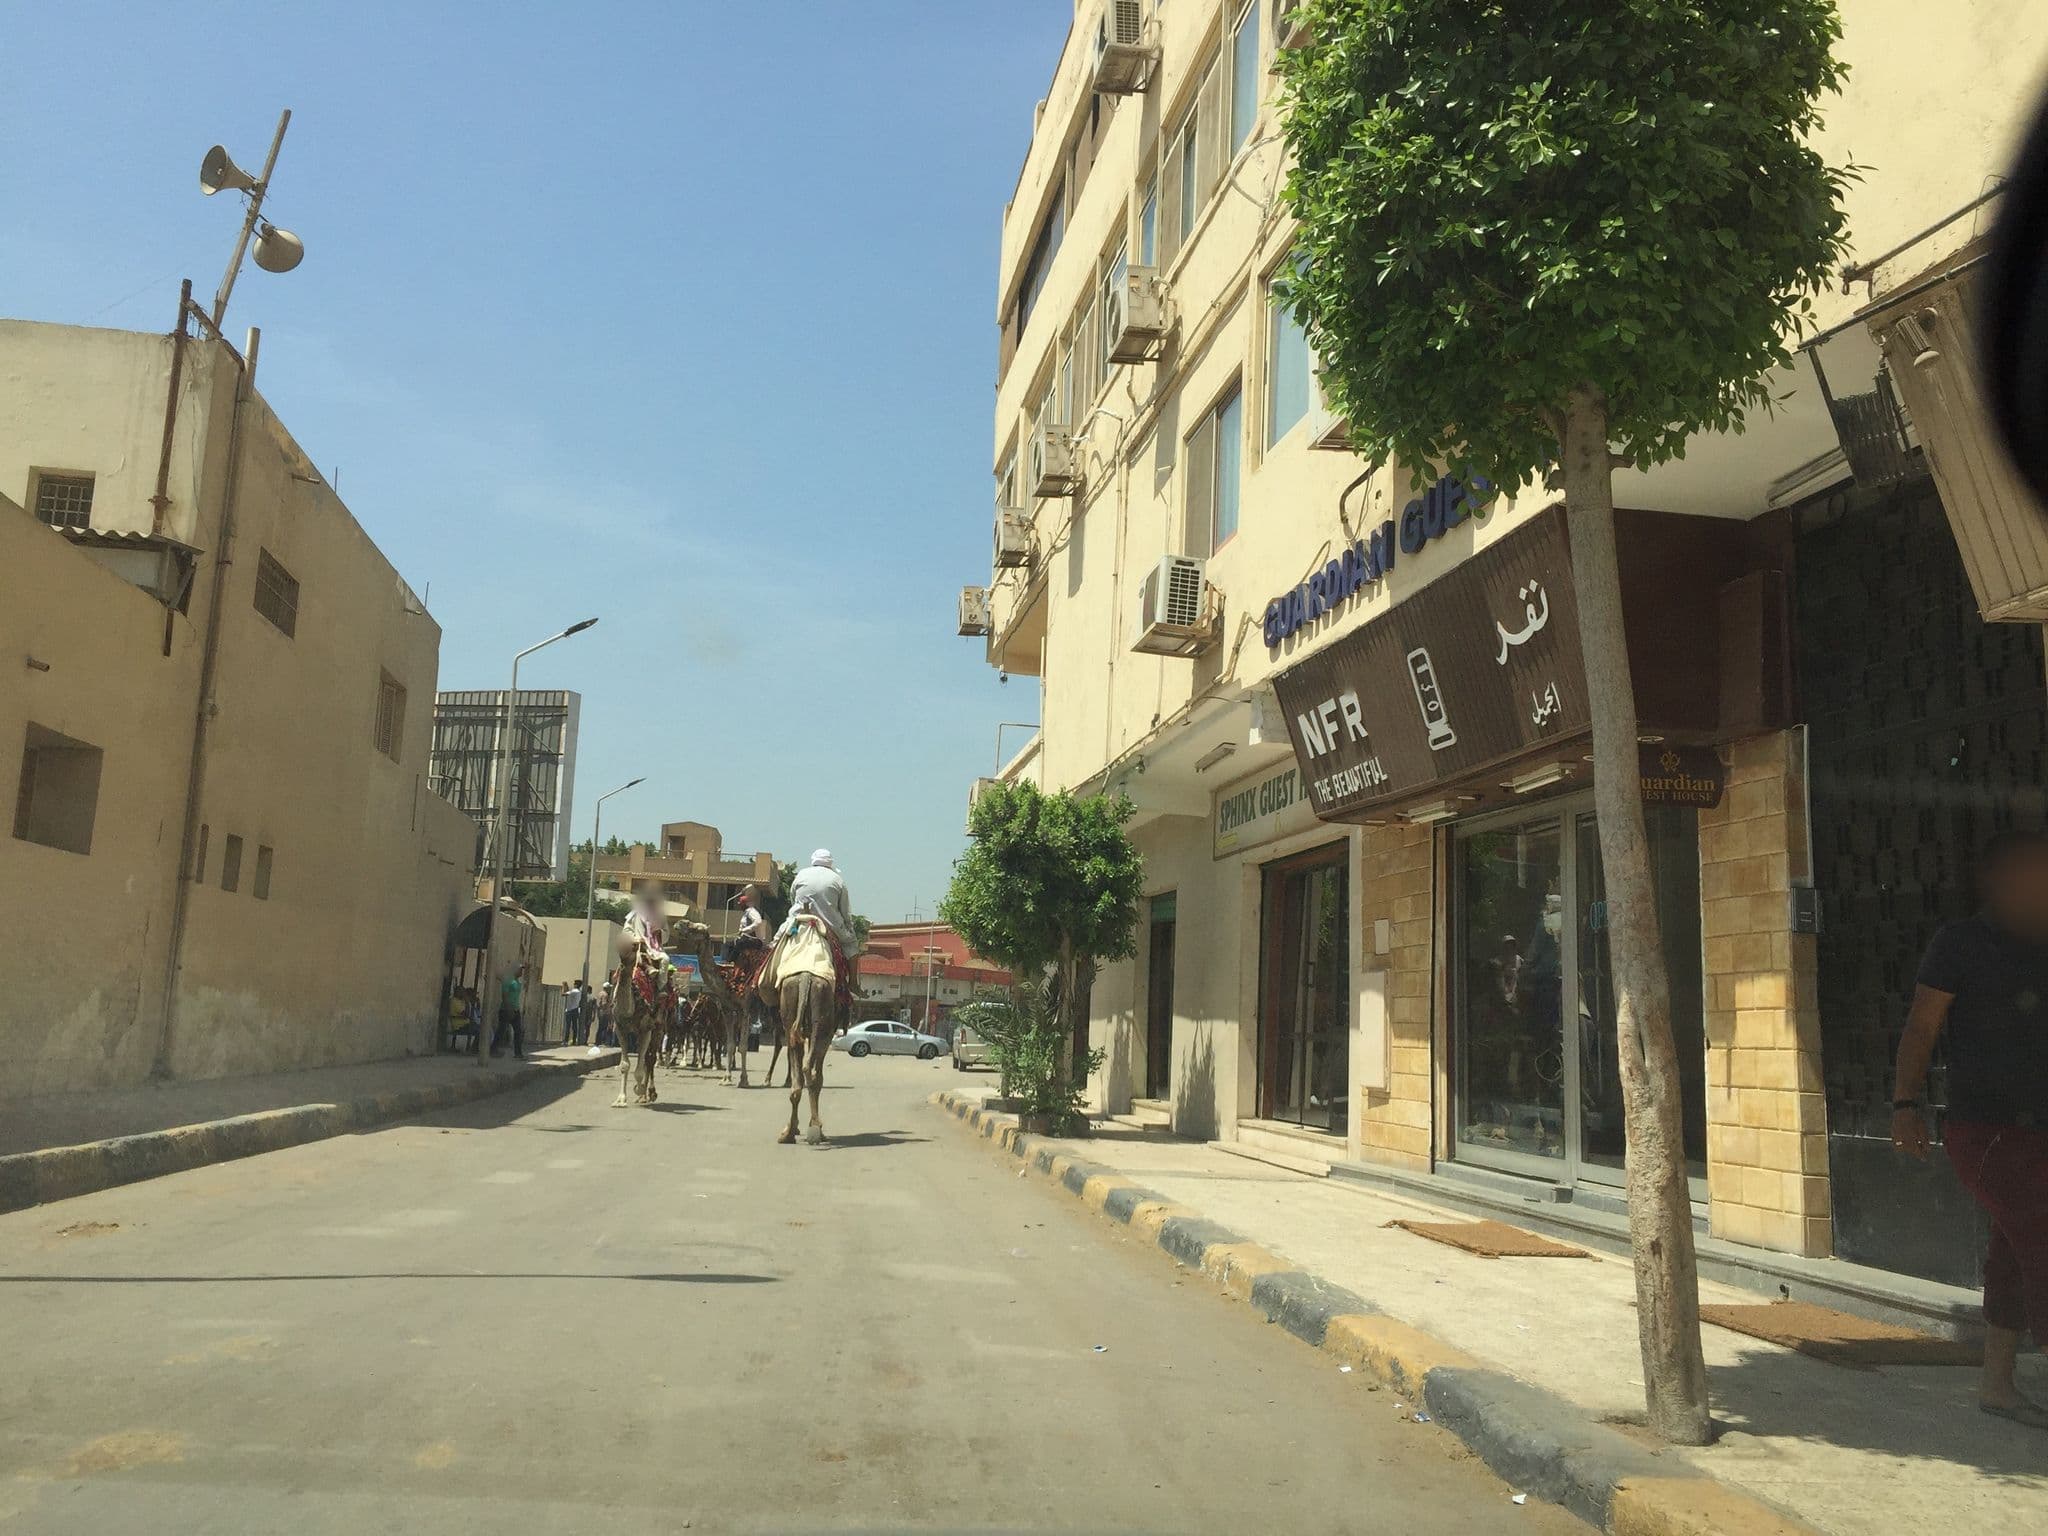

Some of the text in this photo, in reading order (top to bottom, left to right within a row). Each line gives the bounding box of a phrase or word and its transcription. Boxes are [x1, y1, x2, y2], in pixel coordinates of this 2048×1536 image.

[1264, 519, 1396, 648] GUARDIAN
[1495, 579, 1549, 666] نفر
[1297, 690, 1369, 760] NFR
[1532, 680, 1562, 726] الجميل
[1220, 786, 1257, 834] SPHINX
[1259, 768, 1297, 817] GUEST
[1313, 777, 1334, 804] THE
[1332, 756, 1389, 799] BEAUTIFUL
[1640, 773, 1717, 792] uardian
[1641, 790, 1713, 801] EST HOUSE
